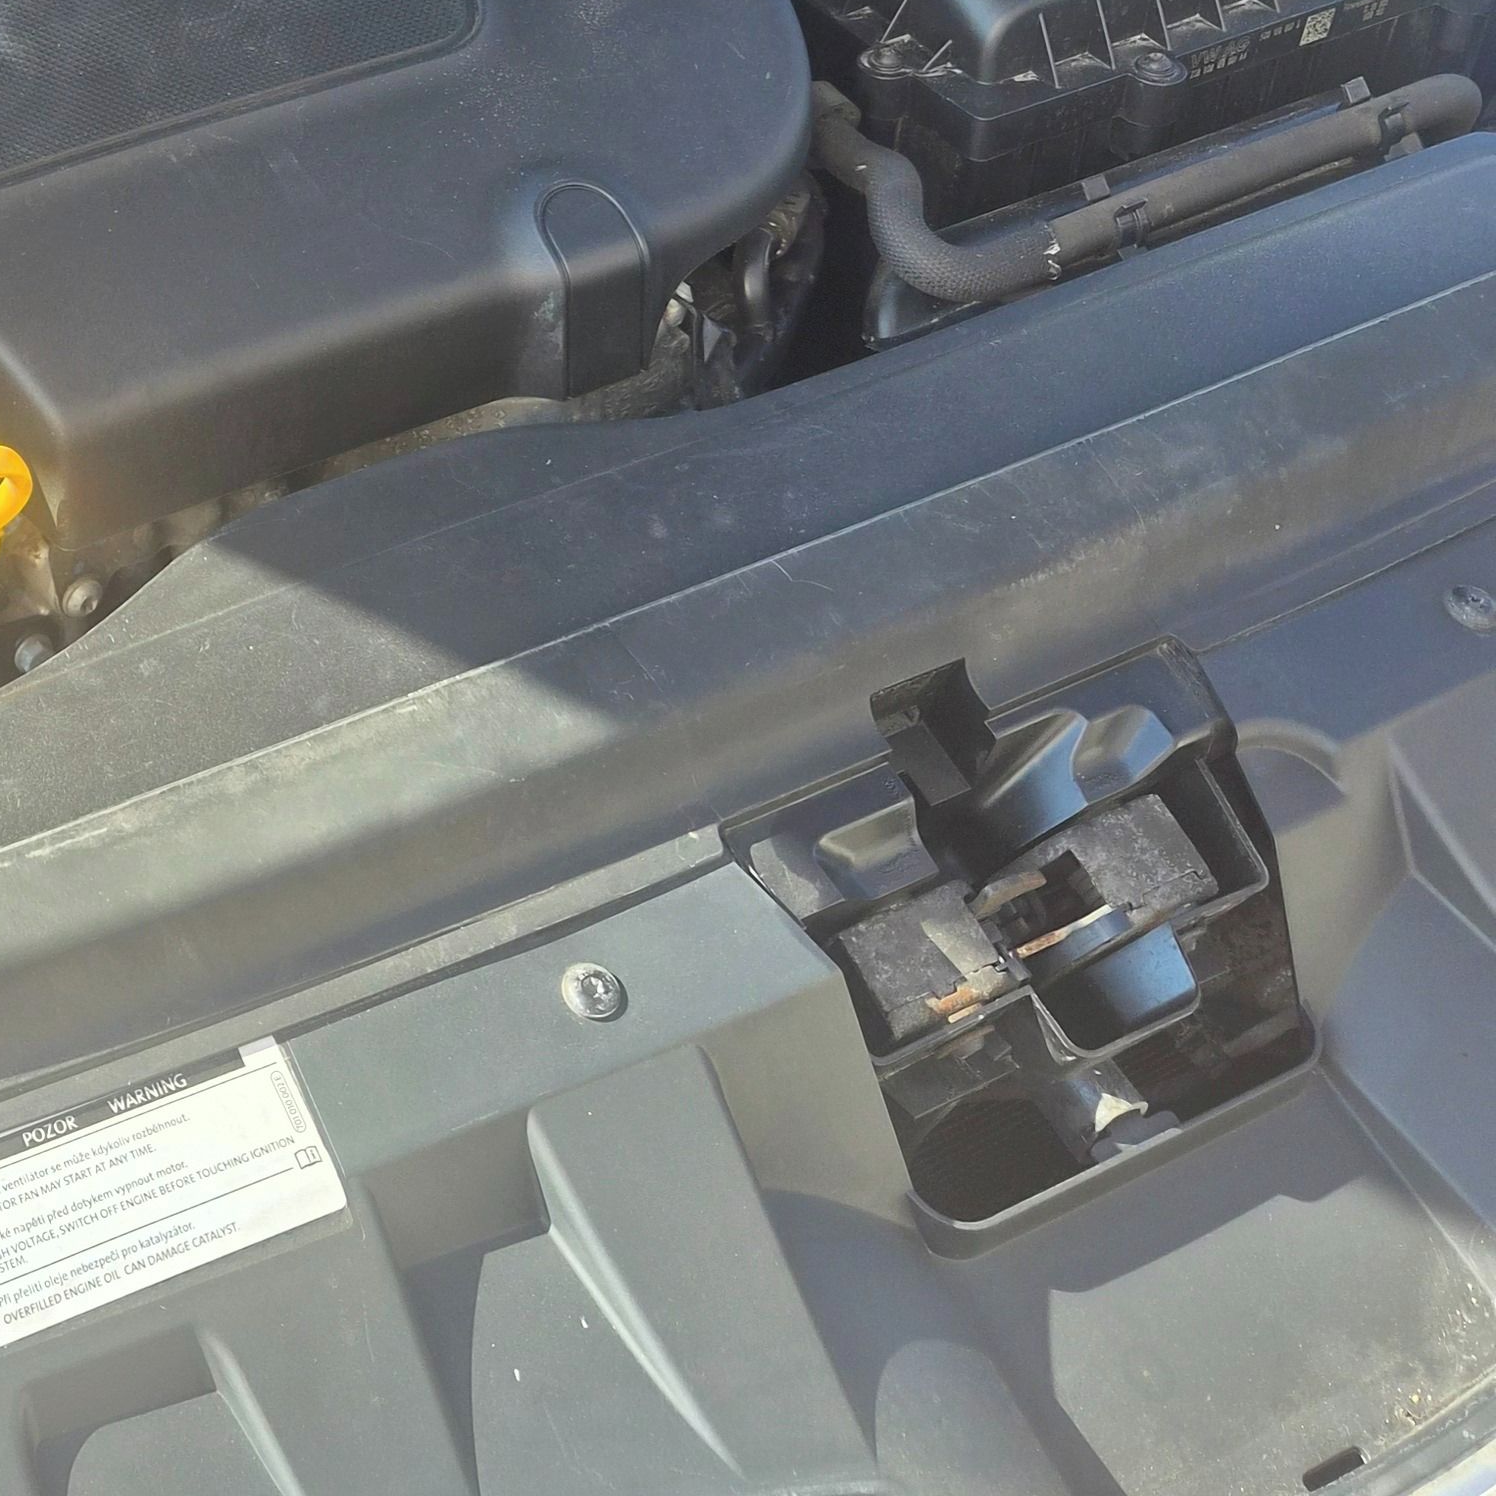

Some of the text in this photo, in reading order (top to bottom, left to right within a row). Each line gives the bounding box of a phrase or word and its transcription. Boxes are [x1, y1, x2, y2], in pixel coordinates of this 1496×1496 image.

[22, 1073, 188, 1147] POZOR WARNING
[18, 1189, 39, 1204] FAN
[39, 1179, 61, 1195] MAY
[63, 1167, 92, 1186] START
[95, 1161, 106, 1174] AT
[109, 1153, 128, 1168] ANY
[129, 1143, 157, 1159] TIME.
[50, 1163, 62, 1173] se
[90, 1136, 130, 1157] kdykoliv
[10, 1229, 59, 1254] VOLTAGE,
[59, 1212, 99, 1235] SWITCH
[99, 1204, 119, 1219] OFF
[119, 1189, 158, 1211] ENGINE
[158, 1173, 196, 1195] BEFORE
[195, 1152, 250, 1179] TOUCHING
[249, 1135, 295, 1159] IGNITION
[70, 1190, 113, 1212] dotykem
[114, 1172, 155, 1196] vypnout
[156, 1161, 188, 1178] motor.
[3, 1293, 62, 1325] OVERFILLED
[63, 1276, 103, 1300] ENGINE
[103, 1269, 121, 1284] OIL
[123, 1259, 146, 1275] CAN
[147, 1240, 191, 1266] DAMAGE
[44, 1272, 69, 1288] oleje
[120, 1244, 138, 1260] pro
